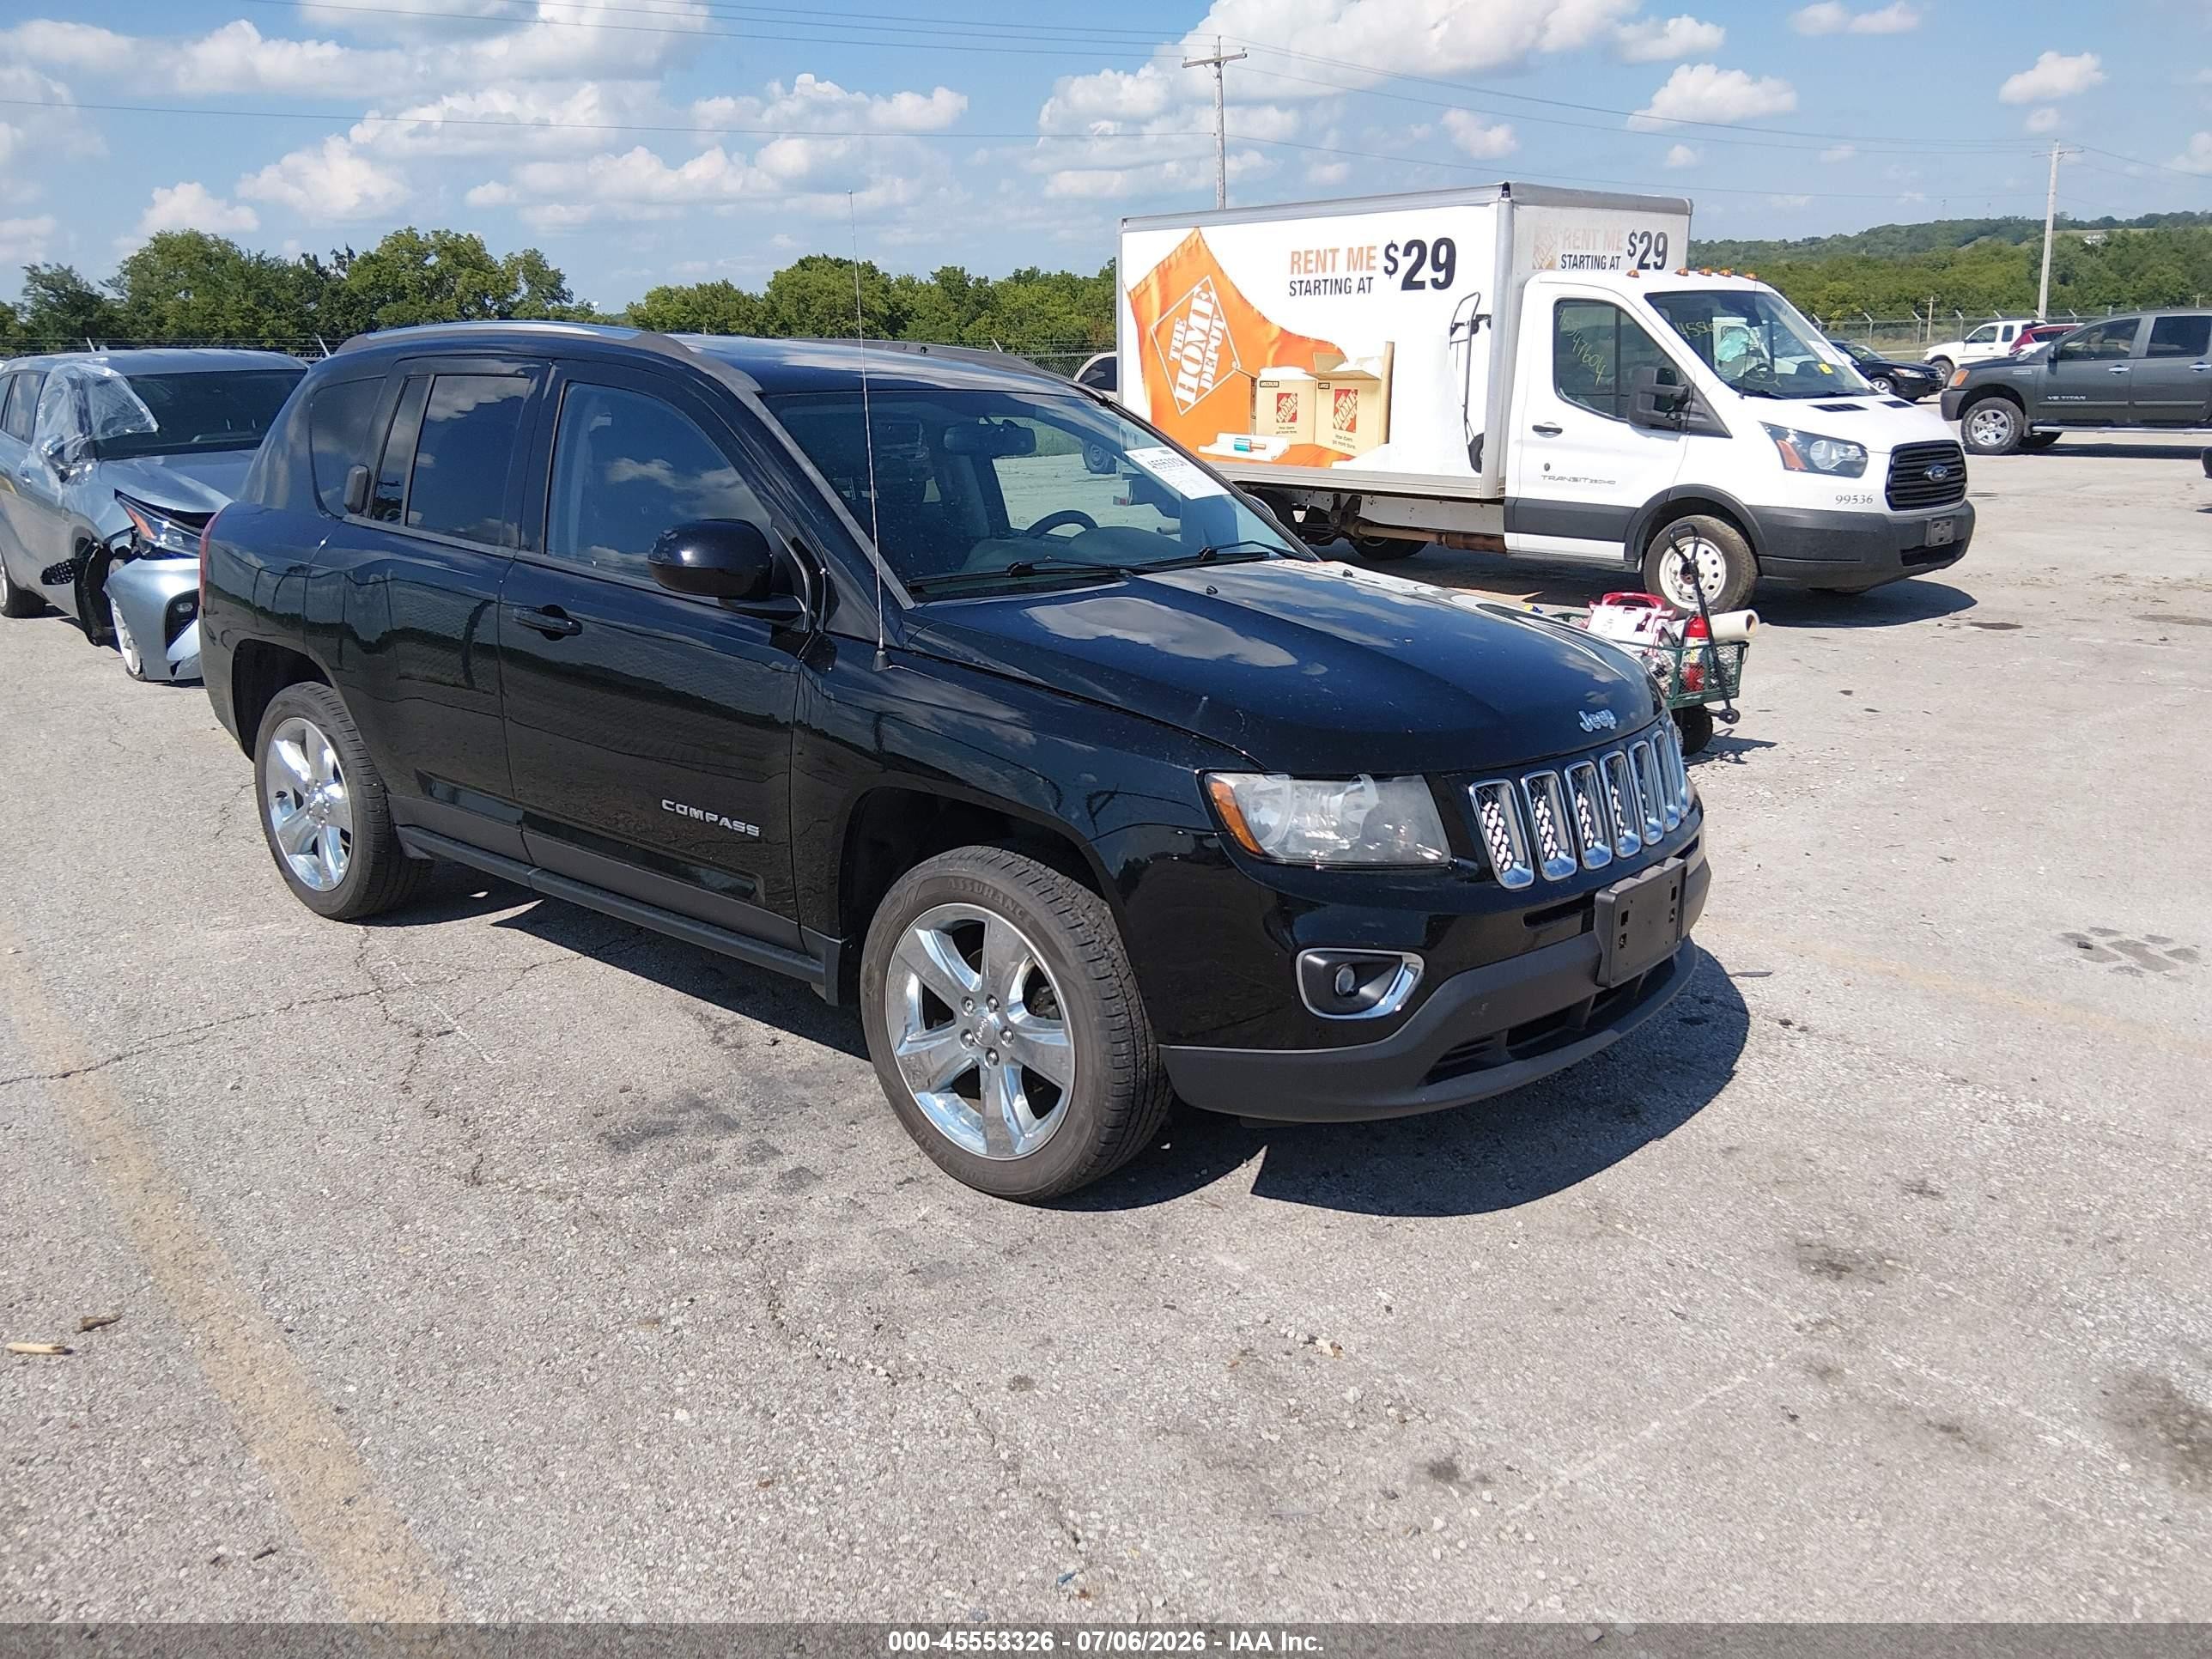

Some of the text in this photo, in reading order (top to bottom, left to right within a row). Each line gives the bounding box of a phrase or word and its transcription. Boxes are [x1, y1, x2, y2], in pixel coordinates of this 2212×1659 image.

[1561, 227, 1601, 250] RENT
[1603, 228, 1622, 251] ME
[1627, 229, 1668, 270] $29
[1290, 246, 1376, 275] RENT ME
[1383, 237, 1456, 291] $29
[1561, 254, 1621, 270] STARTING AT
[1289, 276, 1374, 296] STARTING AT
[1169, 317, 1187, 362] THE
[1175, 287, 1216, 404] HOME
[1199, 314, 1225, 390] DEPOT
[1541, 475, 1589, 483] TRANSIT
[1835, 495, 1874, 505] 99536
[1578, 709, 1616, 732] Jeep
[662, 799, 760, 837] COMPASS
[947, 878, 1036, 926] ASSURANCE
